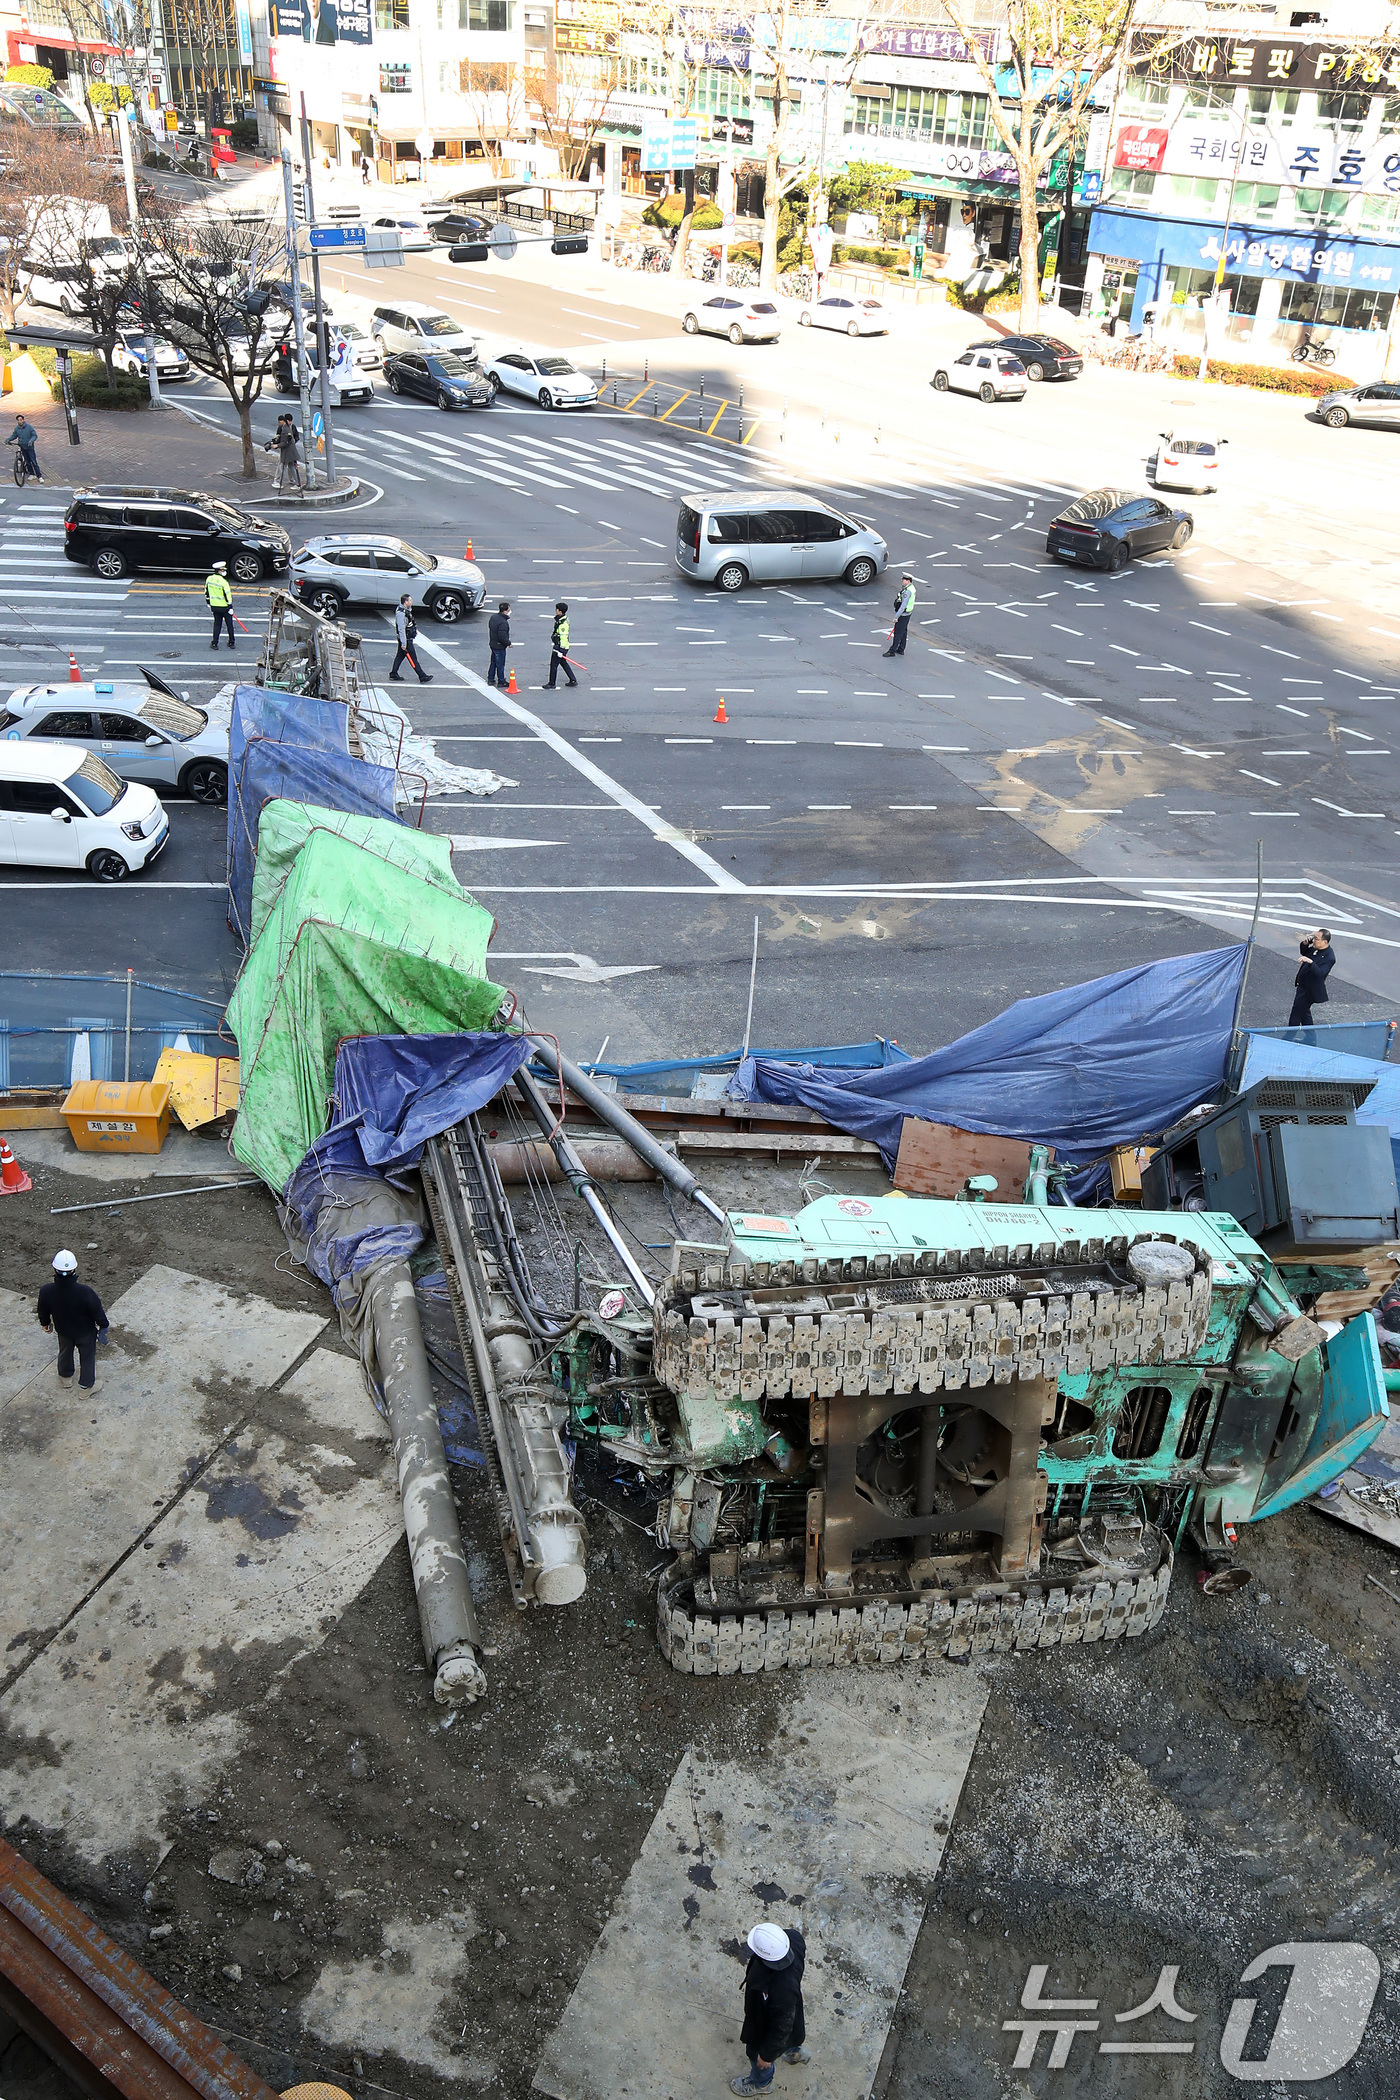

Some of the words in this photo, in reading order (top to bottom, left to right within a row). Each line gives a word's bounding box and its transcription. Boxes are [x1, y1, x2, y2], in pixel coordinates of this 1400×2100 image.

[271, 4, 279, 39] 1
[337, 15, 369, 32] 수성구청장
[94, 63, 103, 71] 60
[1192, 44, 1293, 80] 바로핏
[1314, 50, 1400, 87] PT&
[1122, 139, 1160, 159] 국민의힘
[1189, 137, 1268, 166] 국회의원
[342, 229, 364, 239] 청호로
[1226, 238, 1355, 278] 사암당한의원
[91, 1122, 133, 1131] 제설함
[982, 1210, 1009, 1219] NIPPON
